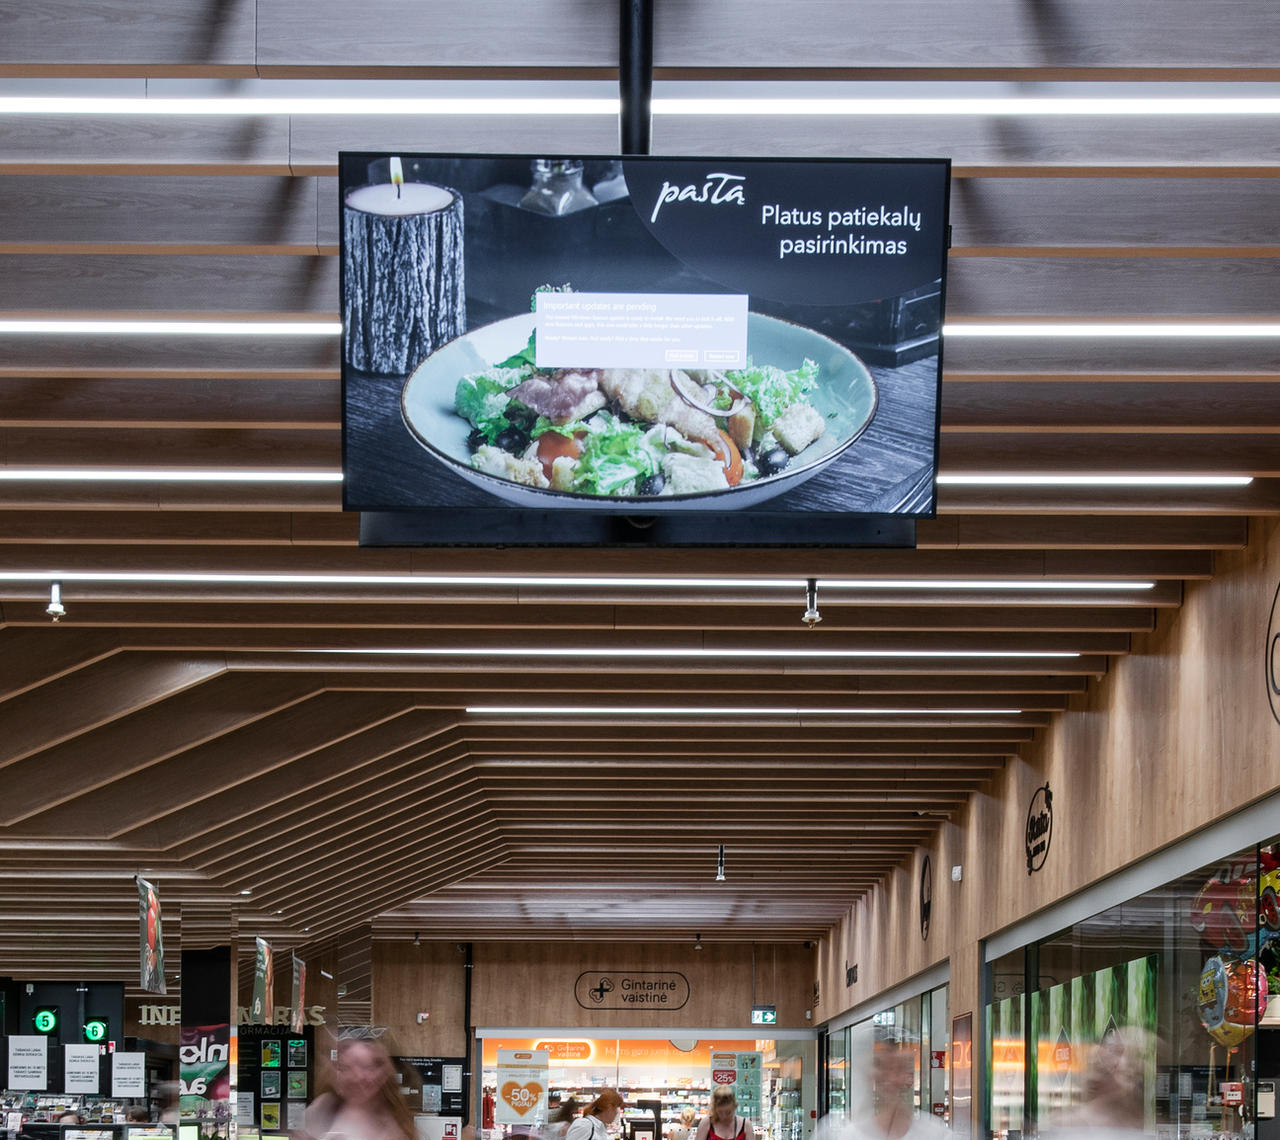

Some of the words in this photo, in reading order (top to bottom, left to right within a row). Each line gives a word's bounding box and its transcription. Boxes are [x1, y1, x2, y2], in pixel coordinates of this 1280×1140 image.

[762, 205, 822, 225] Platus
[828, 206, 921, 232] patiekalų
[780, 234, 907, 258] pasirinkimas
[543, 302, 579, 312] Important
[581, 302, 610, 312] updates
[626, 302, 656, 312] pending
[621, 978, 676, 990] Gintarinė
[621, 992, 667, 1003] vaistinė
[42, 1015, 49, 1028] 5
[92, 1025, 98, 1037] 6
